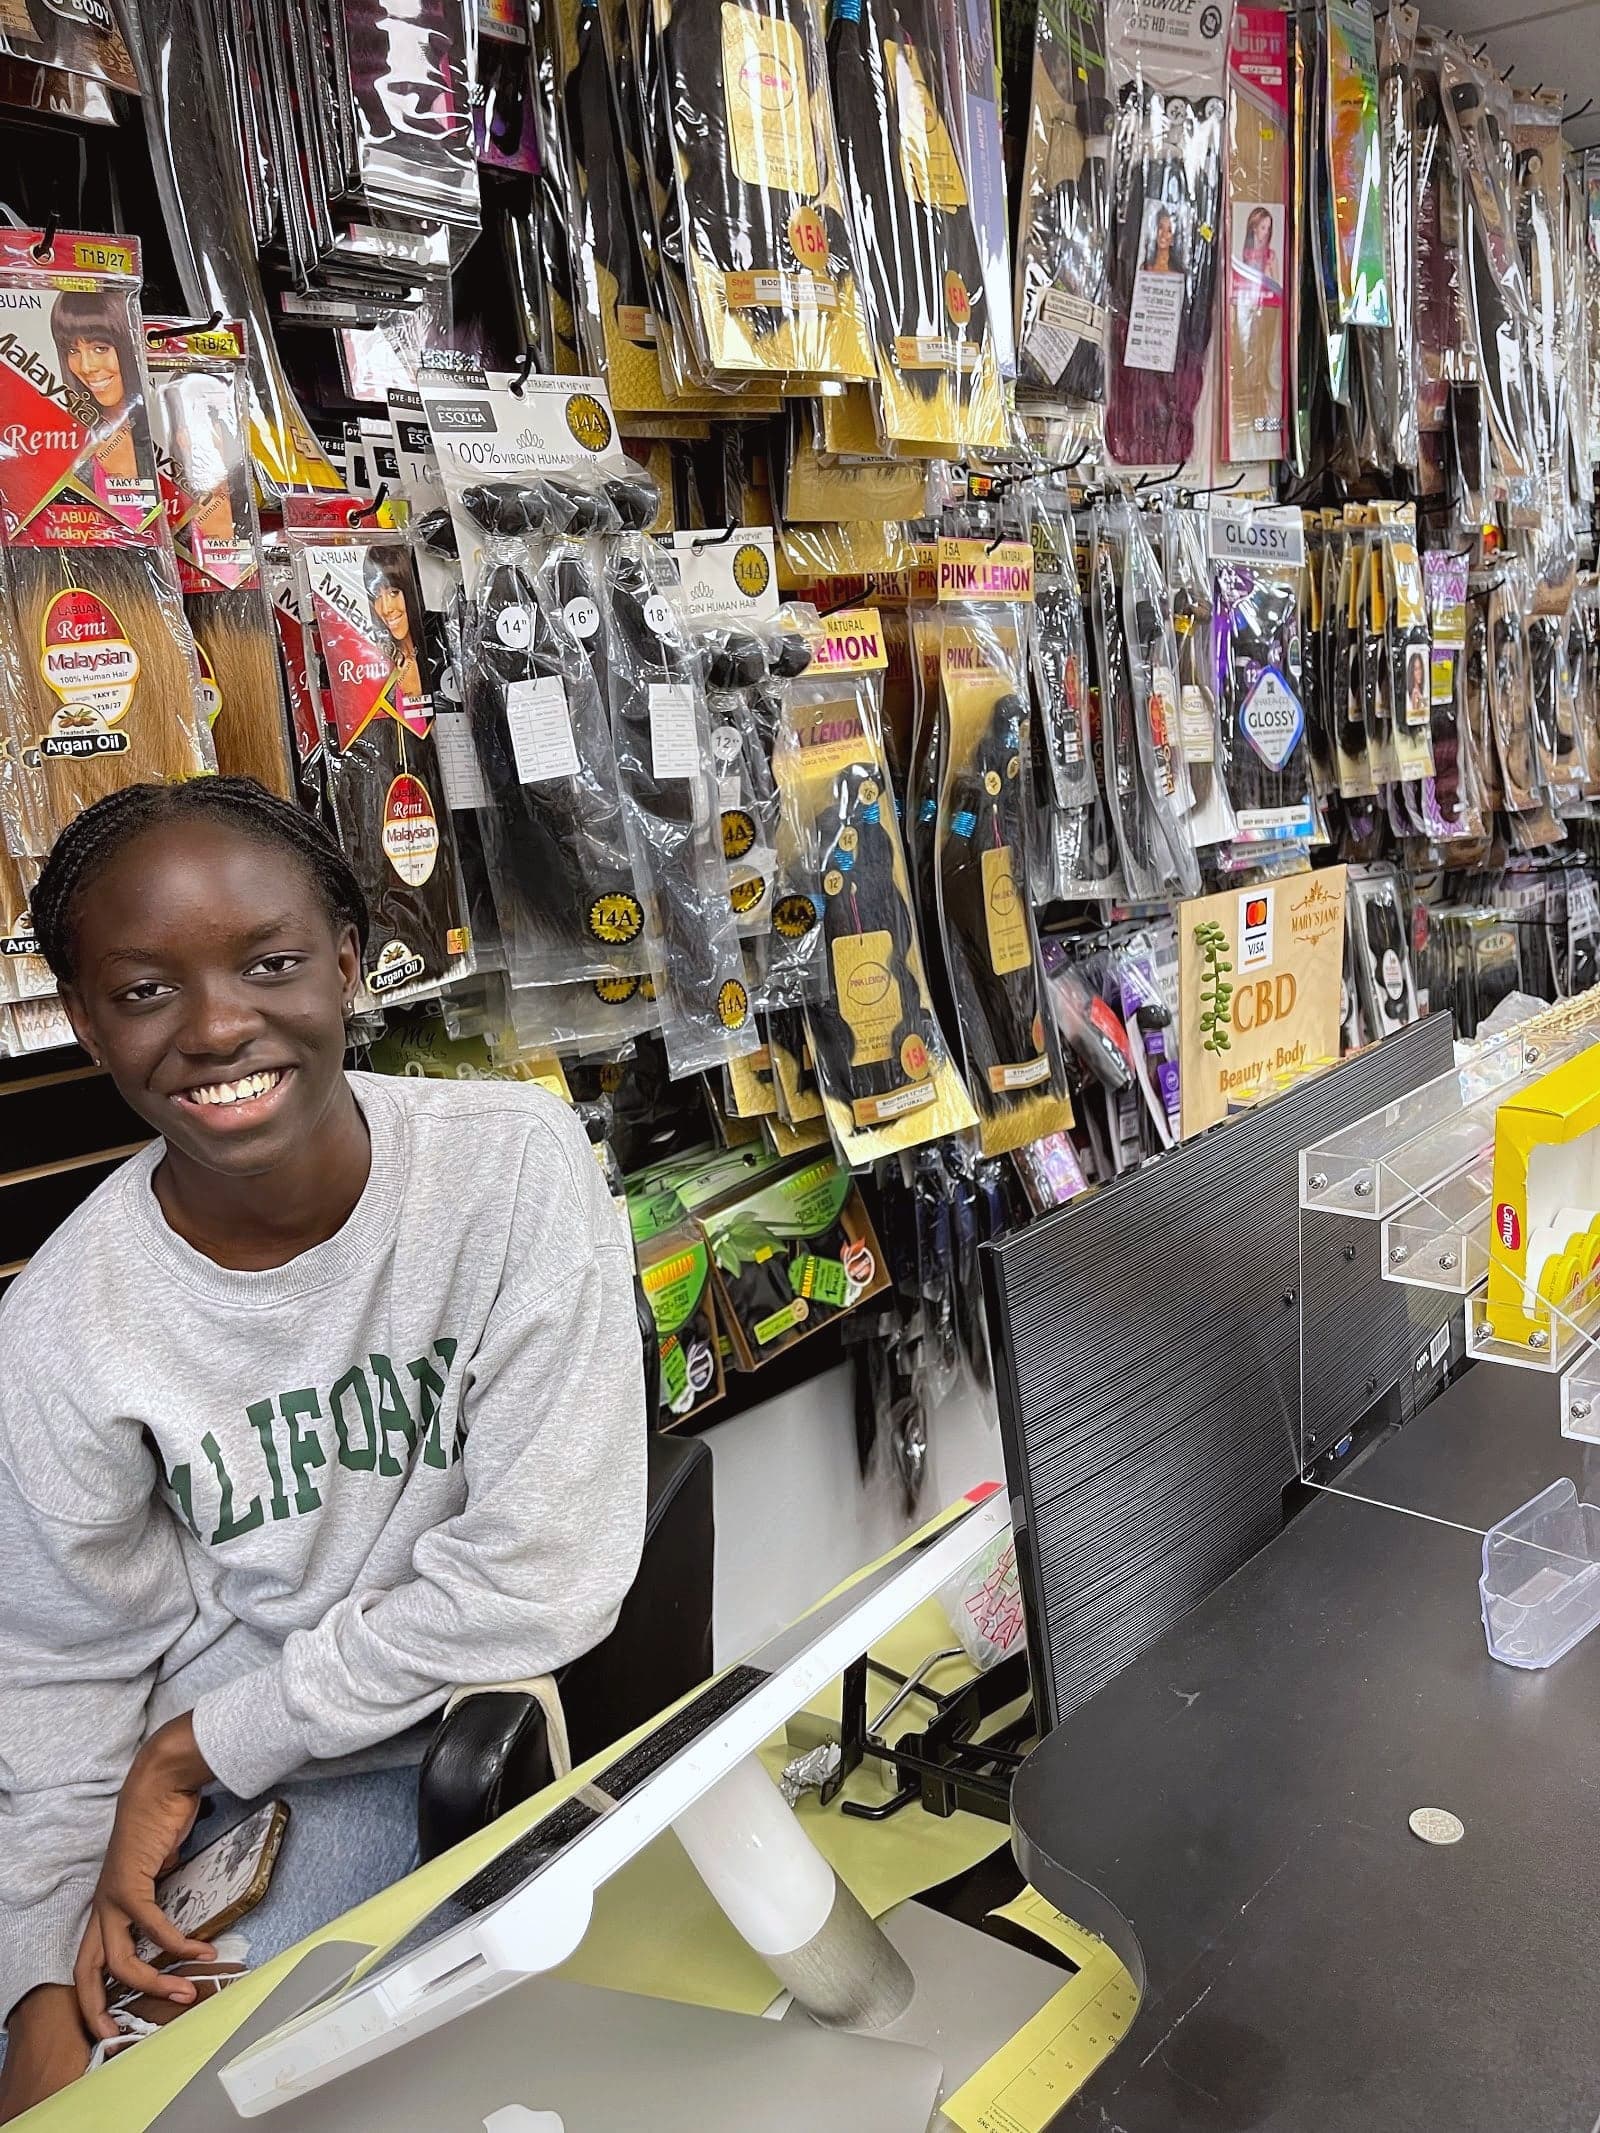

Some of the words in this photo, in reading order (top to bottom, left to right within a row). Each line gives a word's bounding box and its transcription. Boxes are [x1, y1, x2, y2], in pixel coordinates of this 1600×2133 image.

[796, 225, 825, 254] 15A
[81, 248, 125, 268] T1B/27
[193, 336, 235, 352] T1B/27
[4, 424, 80, 452] Remi
[446, 441, 501, 465] 100%
[501, 453, 535, 465] VIRGIN
[207, 539, 230, 548] YAKY
[1226, 523, 1288, 550] GLOSSY
[944, 541, 961, 557] 15A
[738, 565, 765, 581] 14A
[917, 571, 938, 589] PIN
[941, 563, 980, 591] PINK
[983, 563, 1031, 592] LEMON
[568, 609, 594, 625] 16"
[706, 602, 739, 614] HUMAN
[57, 616, 108, 639] Remi
[501, 620, 528, 634] 14"
[827, 620, 865, 633] NATURAL
[815, 634, 879, 664] EMON
[946, 648, 973, 670] PINK
[47, 648, 133, 672] Malaysian
[60, 674, 82, 684] 100%
[82, 672, 111, 683] Human
[112, 670, 129, 679] Hair
[1249, 708, 1297, 729] GLOSSY
[46, 737, 93, 754] Argan
[96, 735, 120, 750] Oil
[393, 799, 423, 818] Remi
[386, 826, 436, 845] Malaysian
[725, 827, 748, 842] 4A
[598, 909, 634, 927] 14A
[1319, 906, 1341, 926] JANE
[6, 939, 41, 953] Arg
[1248, 941, 1266, 956] VISA
[376, 968, 404, 988] Argan
[404, 961, 419, 975] Oil
[720, 995, 744, 1016] 14A
[1232, 972, 1298, 1034] CBD
[1219, 1058, 1264, 1093] Beauty
[1266, 1056, 1274, 1069] +
[1276, 1040, 1308, 1070] Body
[1503, 1205, 1516, 1249] Carmex
[643, 1253, 695, 1293] BRAZILIAN
